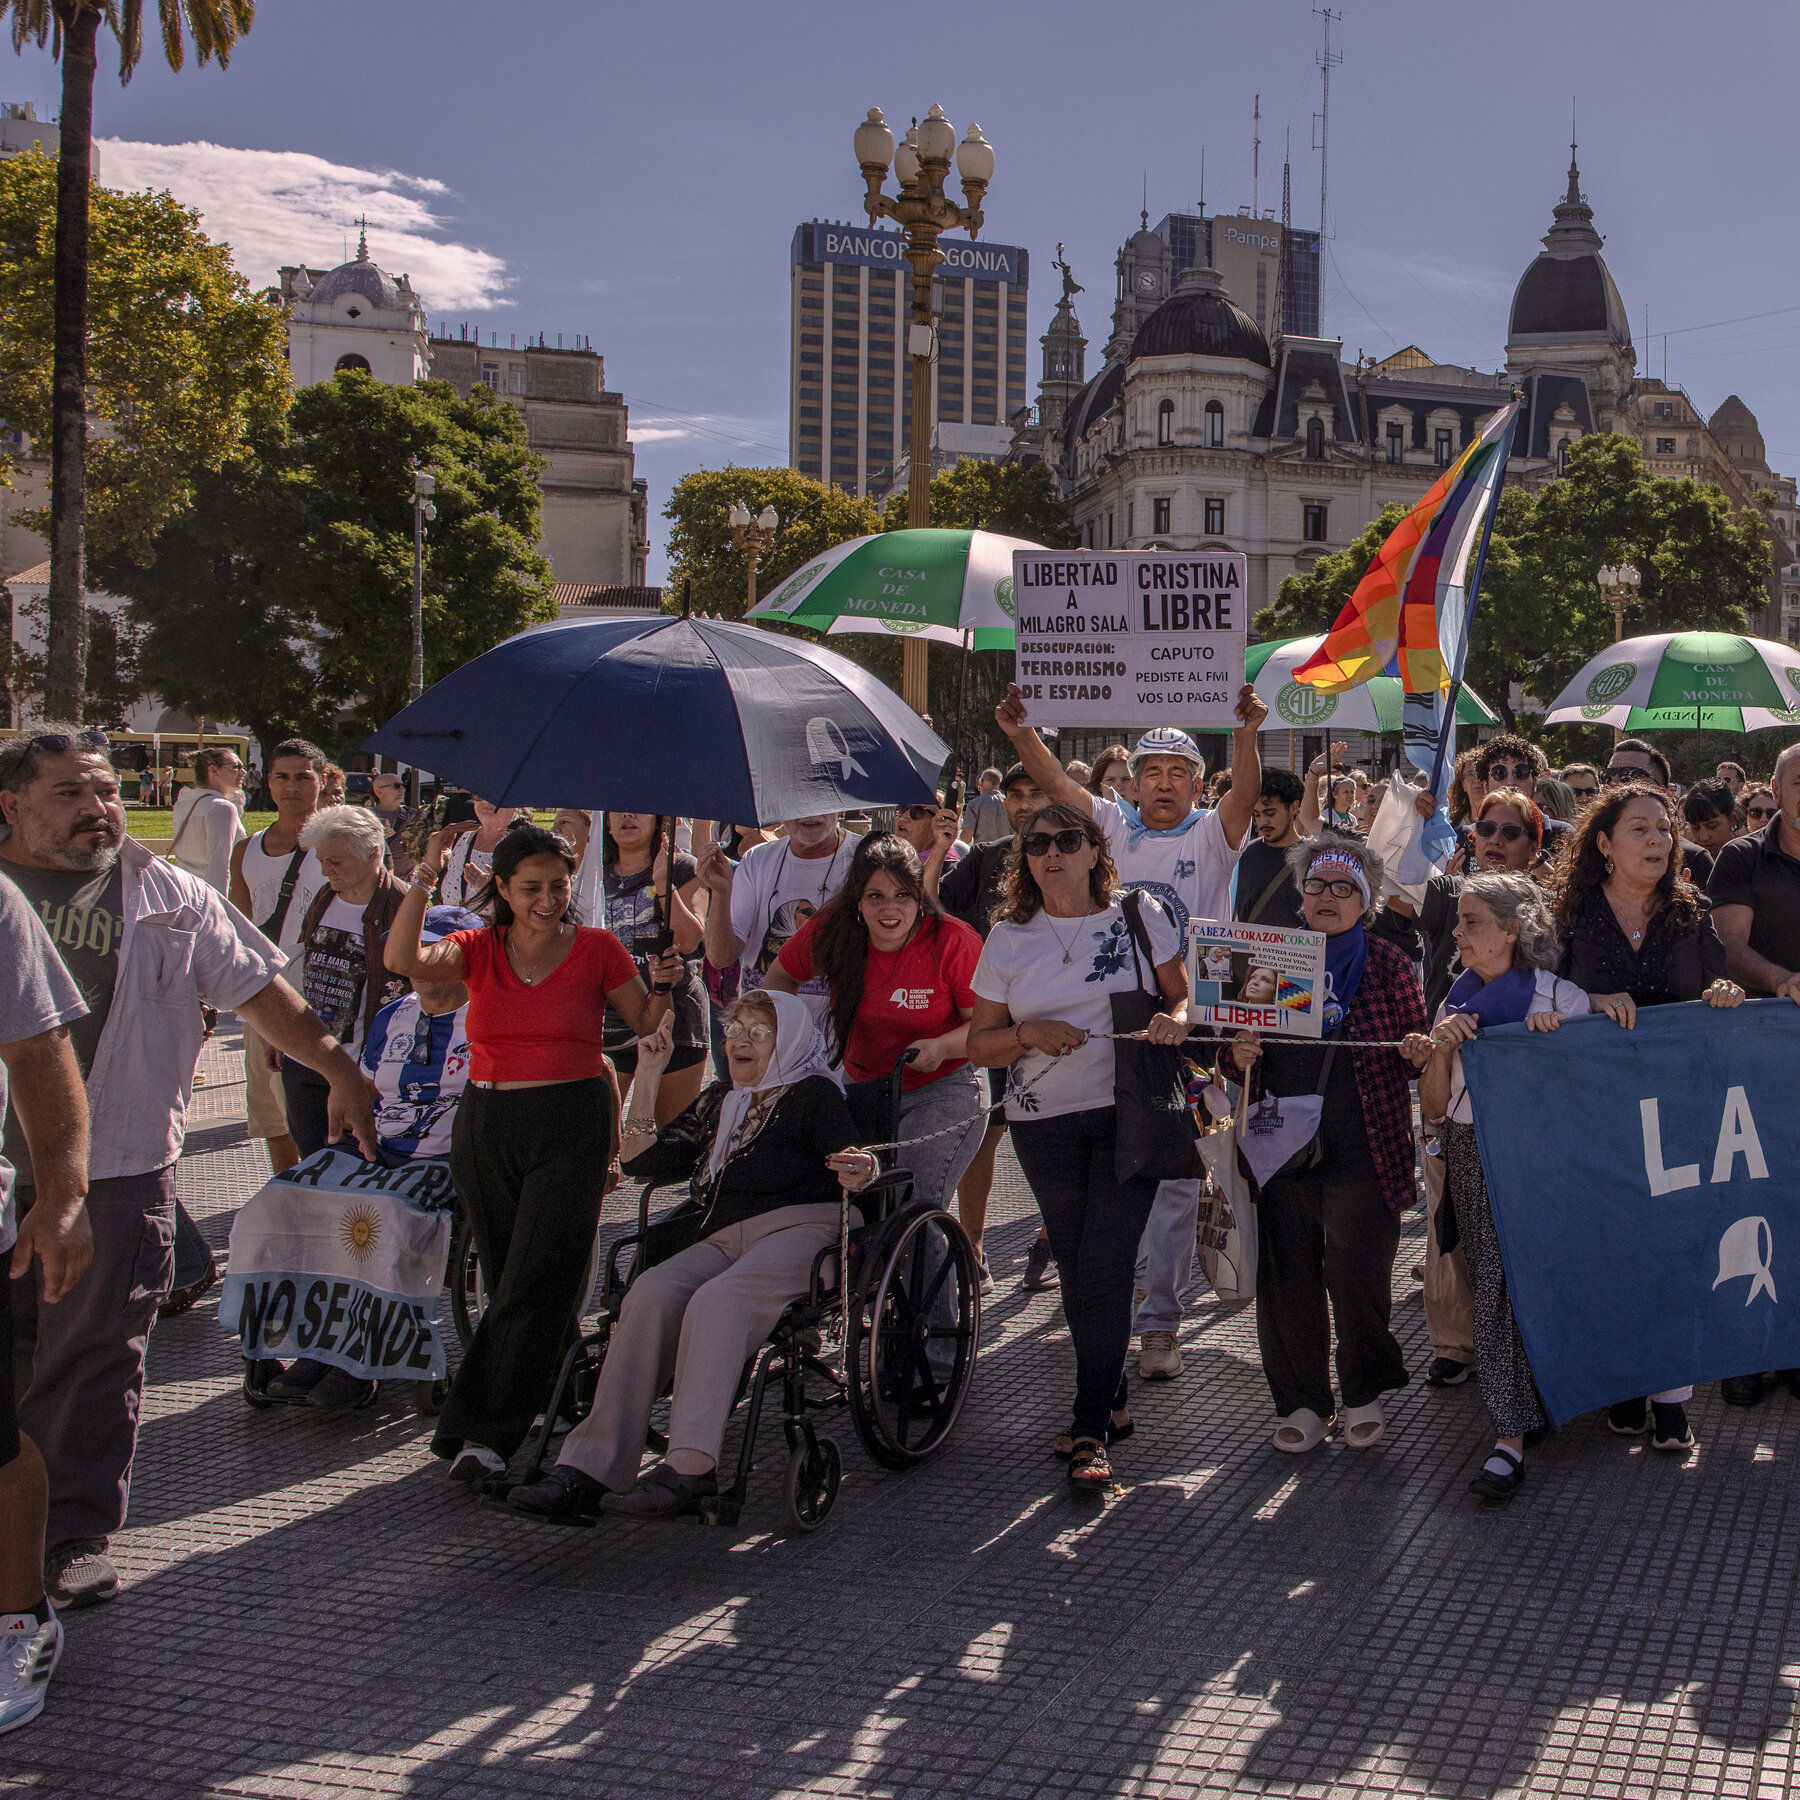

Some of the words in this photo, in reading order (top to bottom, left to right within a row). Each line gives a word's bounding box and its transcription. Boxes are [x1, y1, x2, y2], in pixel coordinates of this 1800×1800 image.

[1225, 228, 1279, 250] Pampa
[878, 567, 927, 581] CASA
[1022, 562, 1118, 587] LIBERTAD
[1137, 562, 1240, 590] CRISTINA
[881, 583, 910, 597] DE
[844, 597, 928, 617] MONEDA
[1066, 589, 1079, 610] A
[1142, 593, 1233, 631] LIBRE
[1020, 616, 1086, 634] MILAGRO
[1090, 615, 1129, 633] SALA
[1021, 640, 1115, 655] DESOCUPACIÓN:
[1150, 647, 1215, 661] CAPUTO
[1021, 660, 1127, 677] TERRORISMO
[1693, 663, 1736, 673] CASA
[1136, 671, 1185, 683] PEDISTE
[1187, 671, 1203, 682] AL
[1205, 671, 1229, 682] FMI
[1705, 676, 1728, 686] DE
[1022, 684, 1043, 700] DE
[1049, 684, 1112, 700] ESTADO
[1137, 692, 1164, 704] VOS
[1167, 692, 1183, 704] LO
[1187, 691, 1229, 704] PAGAS
[1682, 690, 1755, 701] MONEDA
[1313, 860, 1355, 874] LIBRE
[1258, 953, 1277, 961] ESTA
[1262, 947, 1288, 956] PATRIA
[1287, 951, 1318, 961] GRANDE
[1250, 958, 1278, 968] FUERZA
[1278, 962, 1315, 973] CRISTINA!
[1249, 1118, 1283, 1128] CRISTINA
[1639, 1085, 1770, 1197] LA
[238, 1278, 297, 1350] NO
[296, 1279, 351, 1350] SE
[337, 1287, 433, 1370] VENDE
